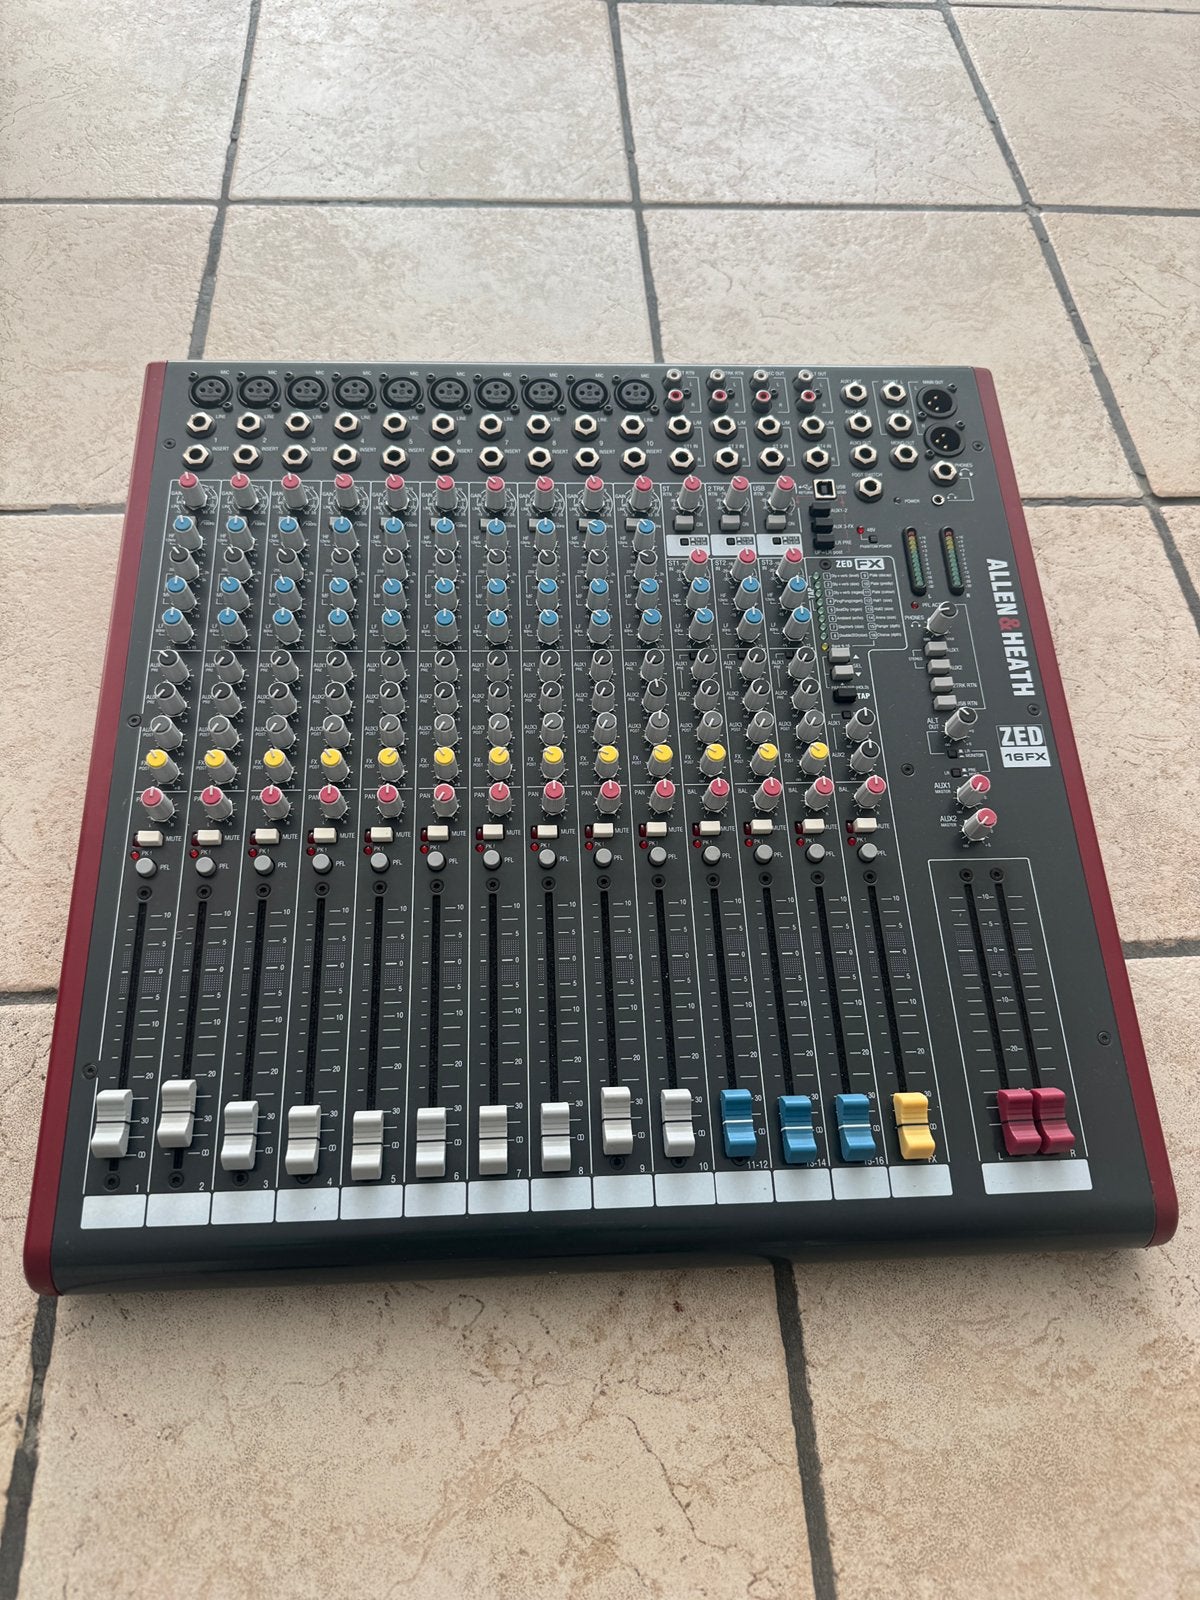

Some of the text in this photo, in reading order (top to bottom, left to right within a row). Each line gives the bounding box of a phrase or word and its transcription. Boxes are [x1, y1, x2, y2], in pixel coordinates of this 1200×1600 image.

[999, 726, 1043, 746] ZED
[1004, 752, 1047, 762] 16FX
[640, 1164, 645, 1172] 9
[700, 1162, 708, 1170] 10
[747, 1160, 768, 1169] 11-12
[516, 1169, 522, 1177] 7
[578, 1166, 584, 1175] 8
[391, 1175, 396, 1183] 5
[454, 1172, 459, 1180] 6
[199, 1182, 204, 1190] 2
[263, 1180, 268, 1188] 3
[327, 1178, 332, 1186] 4
[135, 1184, 140, 1193] 1
